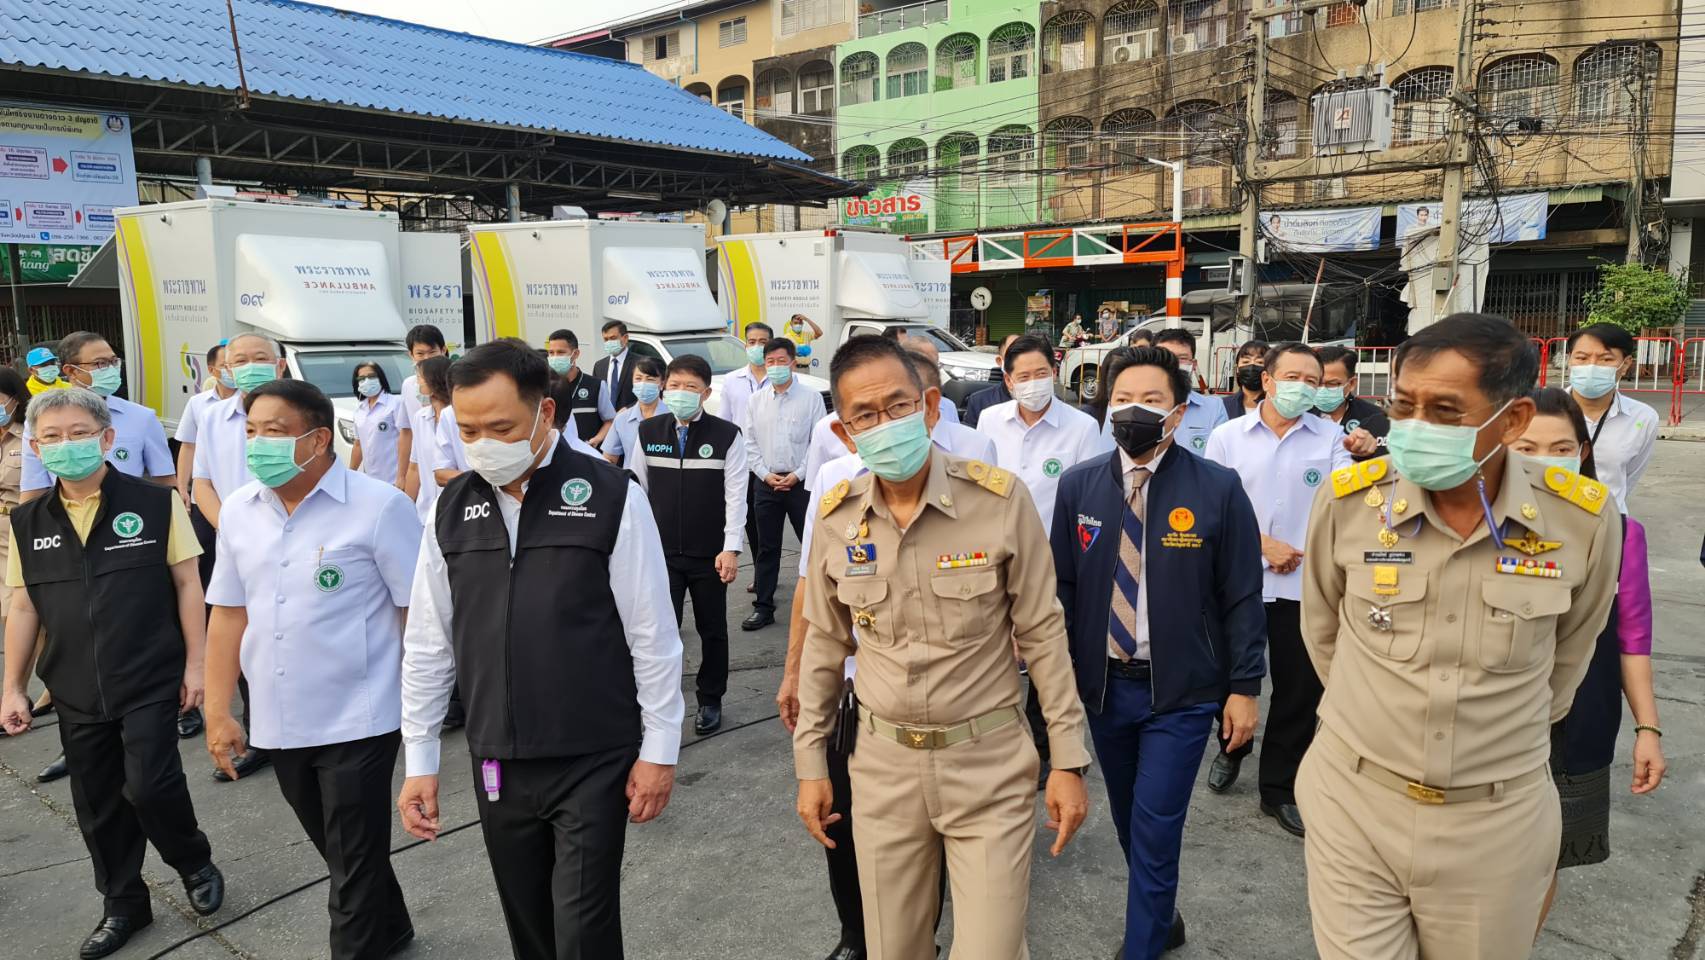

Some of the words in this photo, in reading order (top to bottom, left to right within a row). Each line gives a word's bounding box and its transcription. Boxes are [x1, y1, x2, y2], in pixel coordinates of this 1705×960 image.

[20, 258, 49, 272] hang
[295, 265, 370, 276] พระราชทาน
[163, 280, 206, 294] พระราชทาน
[408, 284, 461, 299] พระรา
[526, 283, 578, 296] พระราชทาน
[770, 280, 820, 290] พระราชทาน
[646, 443, 673, 453] MOPH
[463, 501, 491, 522] DDC
[33, 534, 61, 551] DDC
